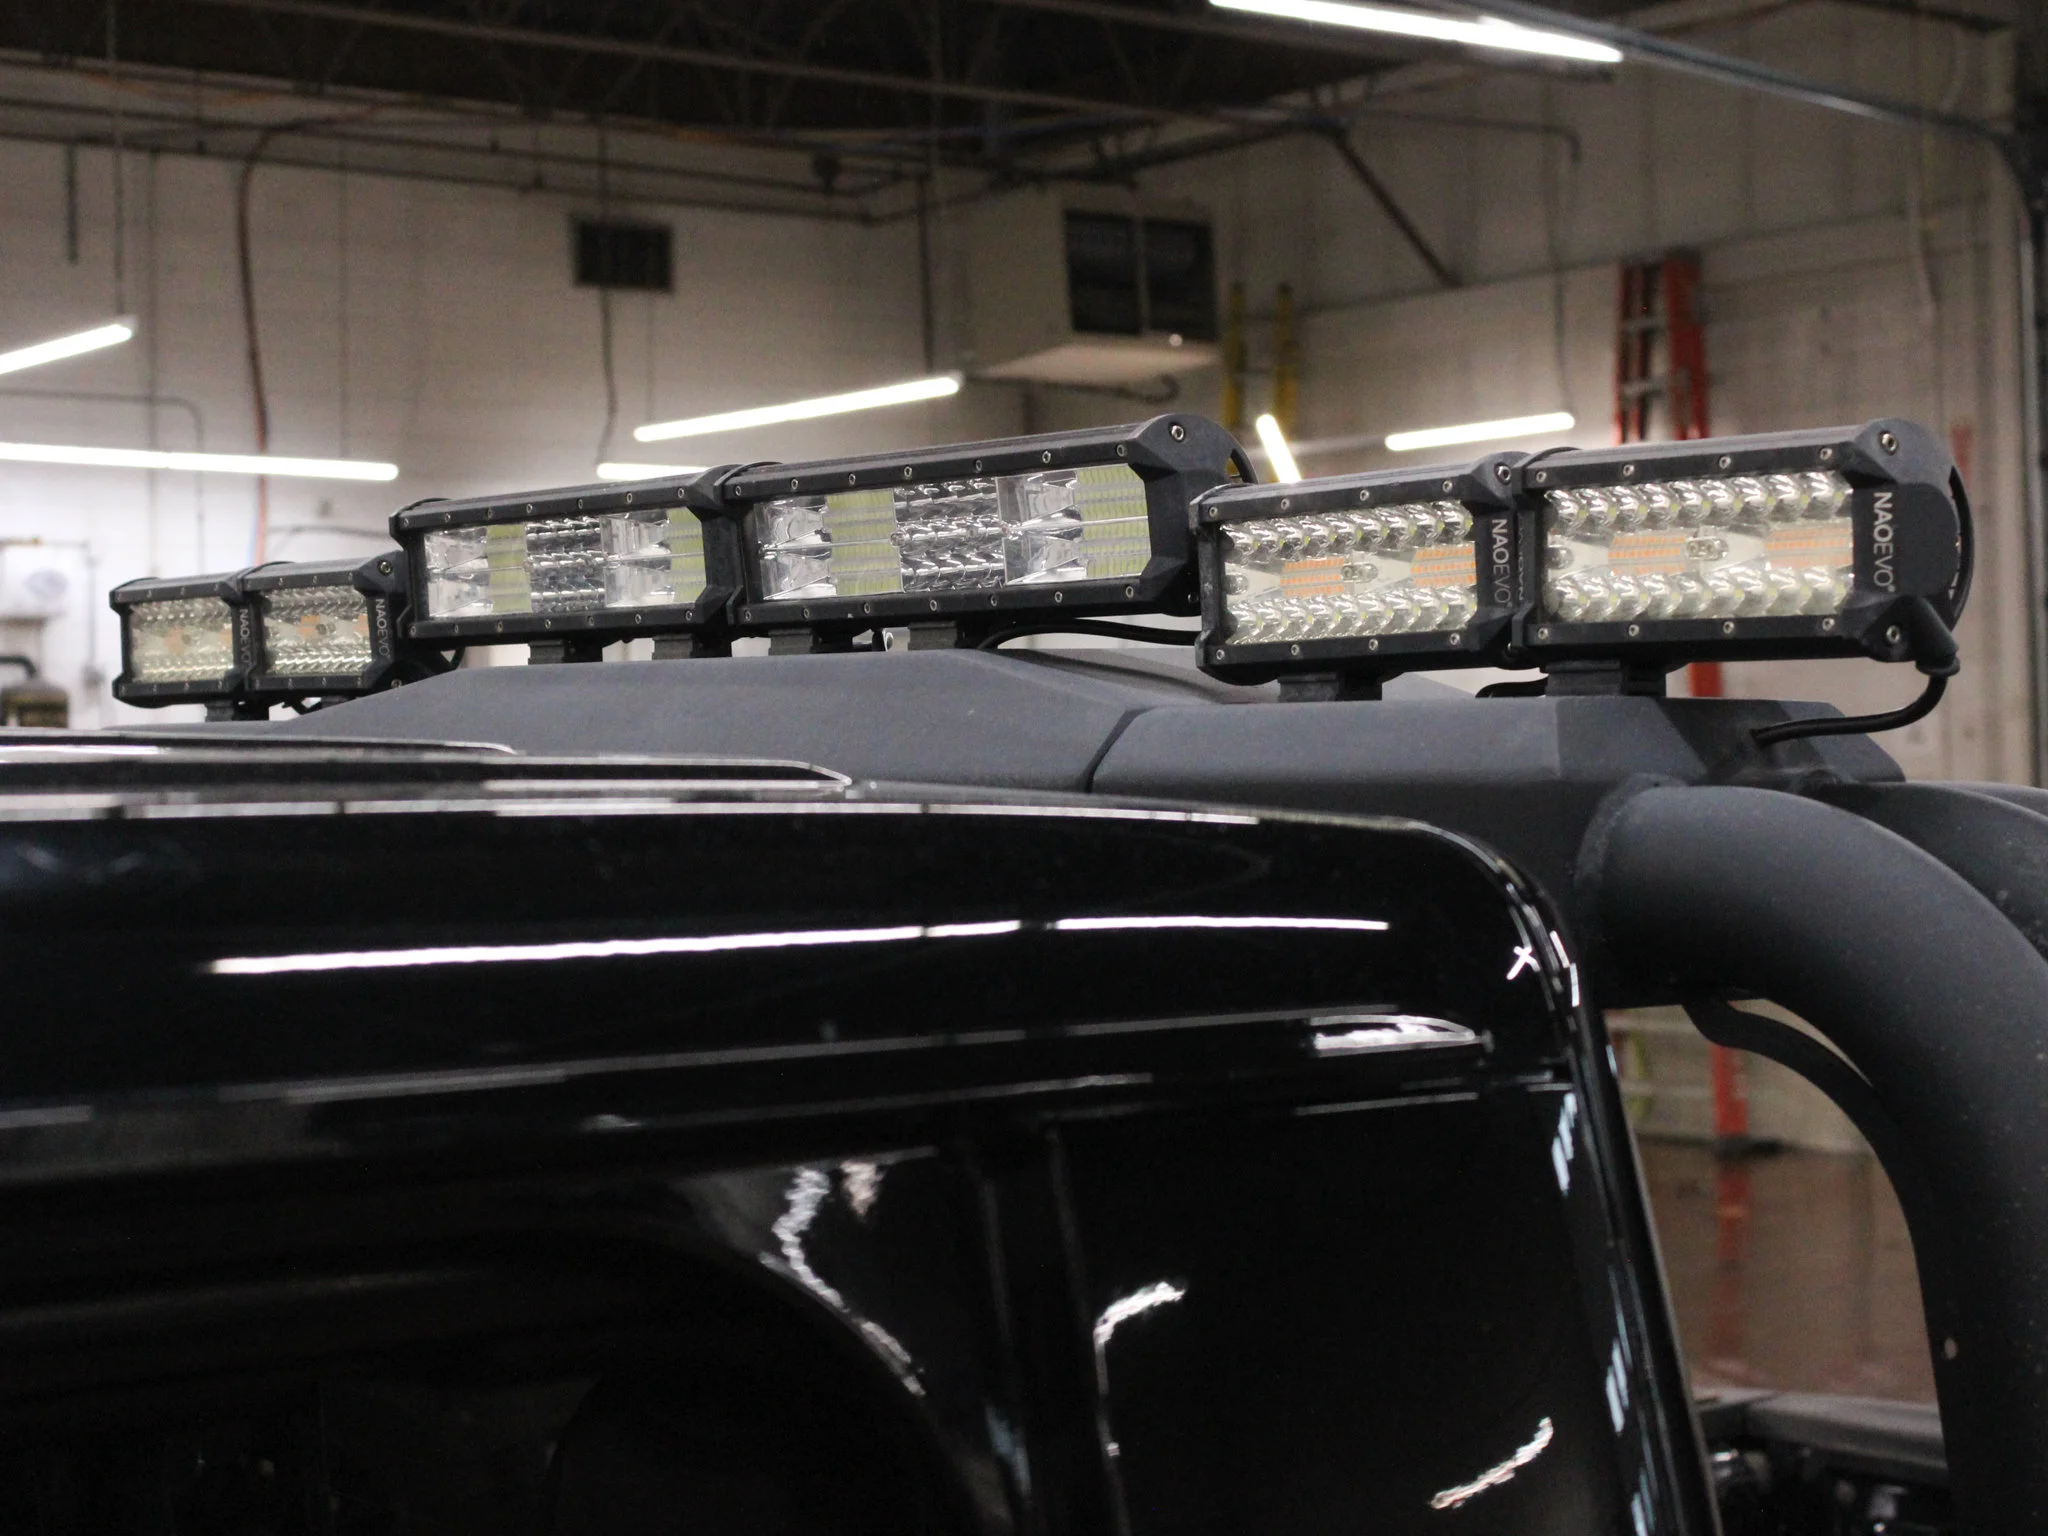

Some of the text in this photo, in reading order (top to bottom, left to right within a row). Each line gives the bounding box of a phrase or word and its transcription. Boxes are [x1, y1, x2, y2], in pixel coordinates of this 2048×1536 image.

[1491, 519, 1511, 603] NAOEVO
[1873, 492, 1894, 588] NAOEVO
[375, 598, 390, 657] NAOEVO
